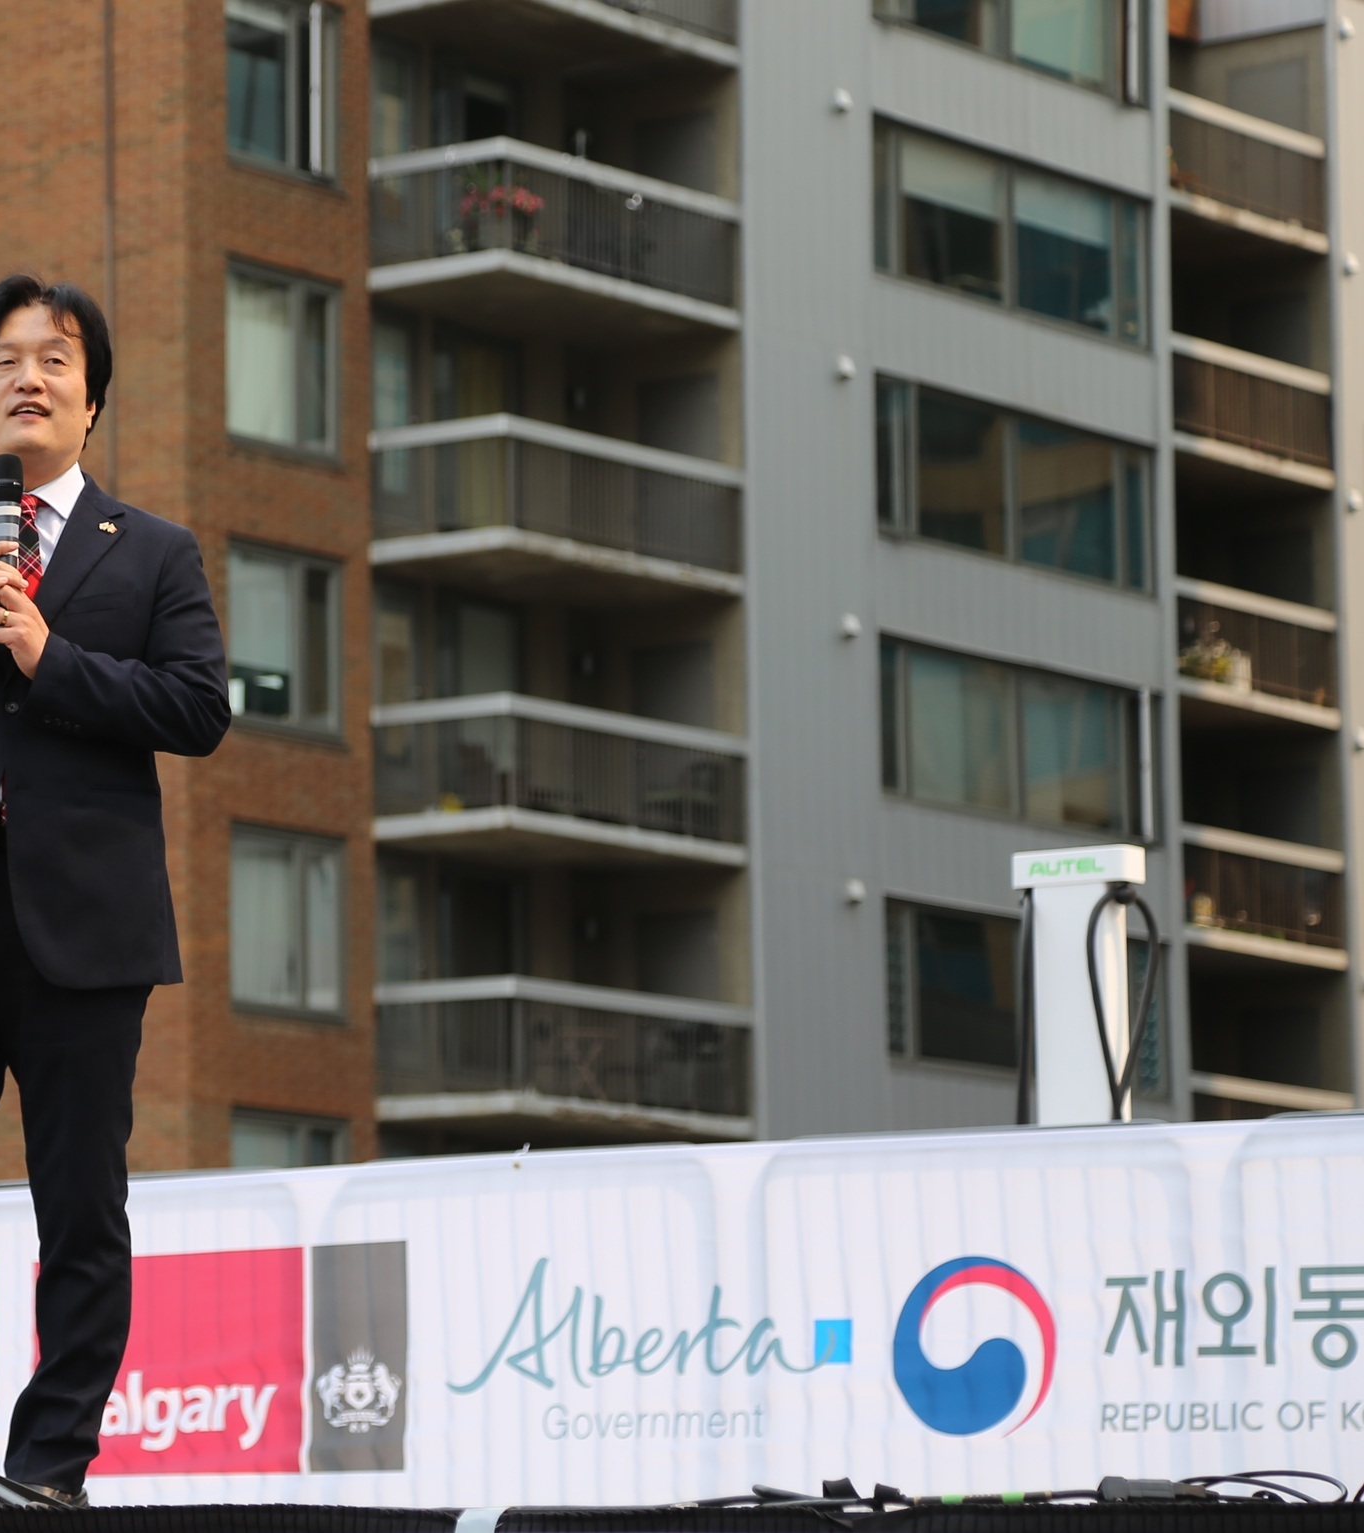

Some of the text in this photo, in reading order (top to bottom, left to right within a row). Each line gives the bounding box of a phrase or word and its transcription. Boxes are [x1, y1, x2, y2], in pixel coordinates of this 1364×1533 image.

[1029, 857, 1105, 878] AUTEL
[445, 1257, 837, 1395] Alberta
[1103, 1265, 1364, 1369] 재외동
[100, 1370, 278, 1451] algary
[543, 1402, 764, 1440] Government
[1100, 1402, 1263, 1433] REPUBLIC
[1276, 1401, 1327, 1432] OF
